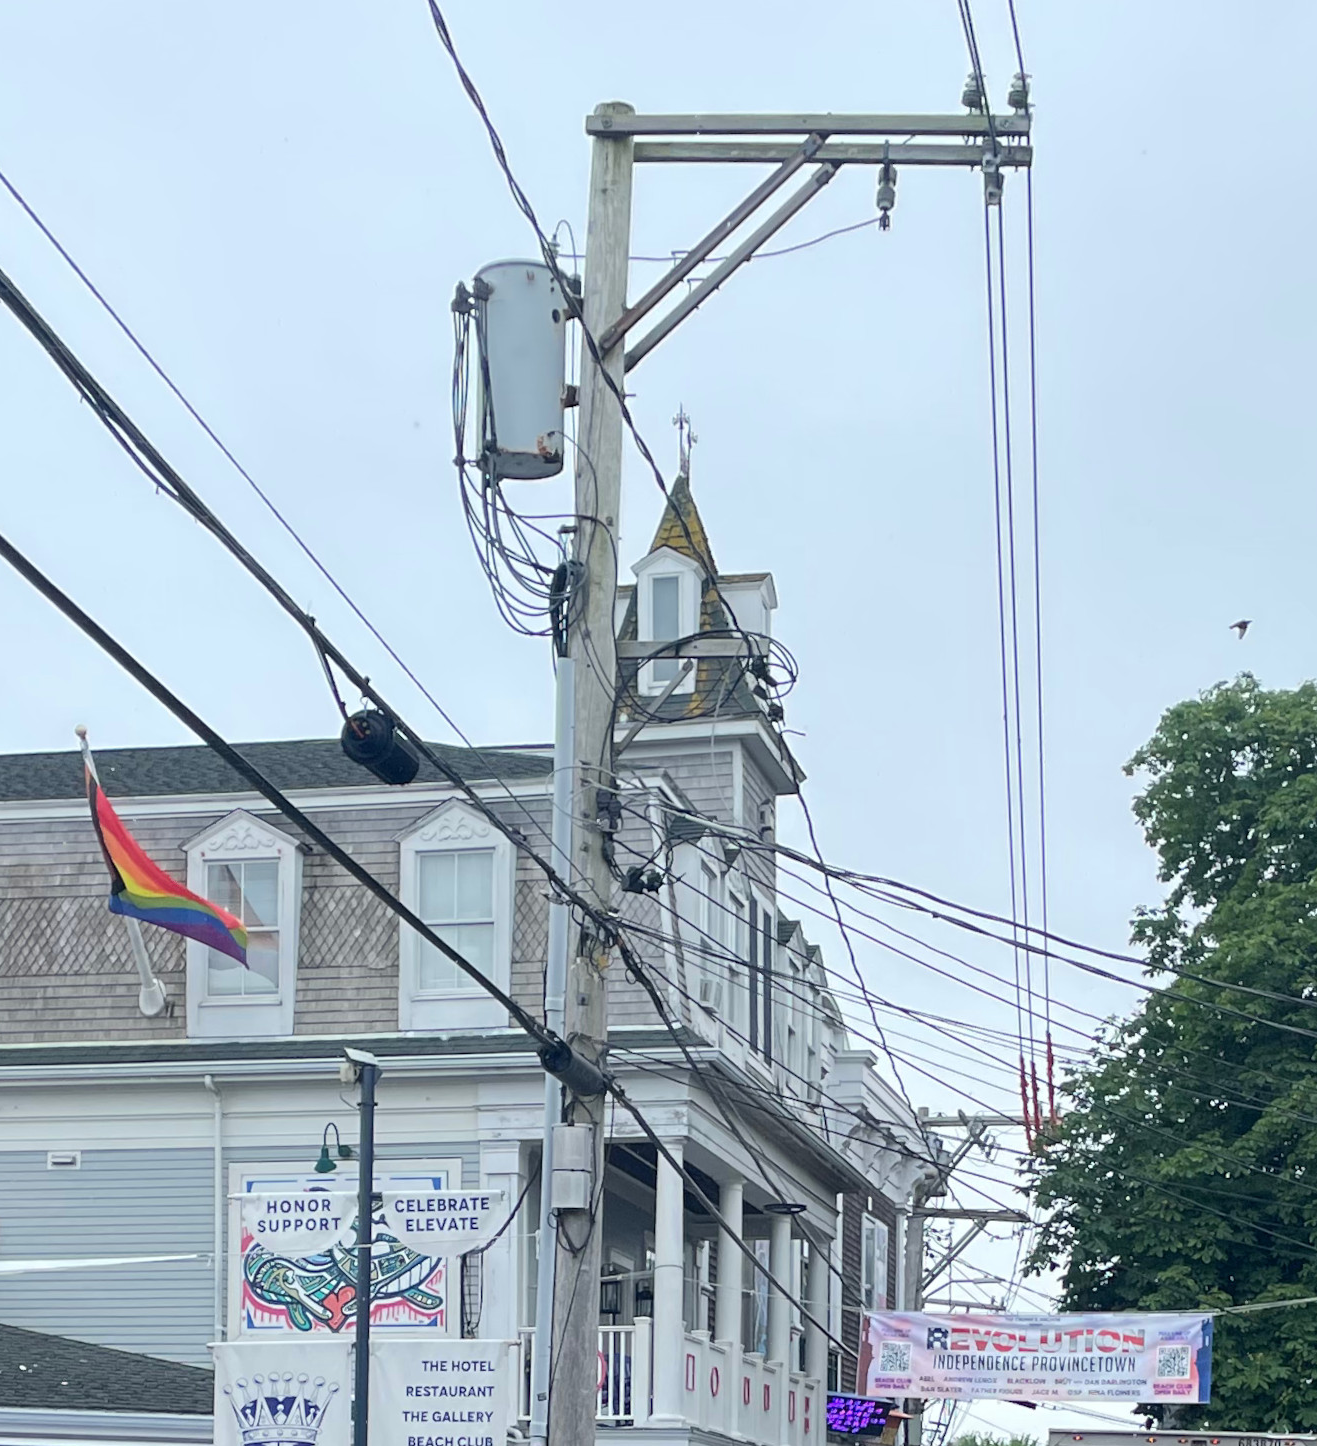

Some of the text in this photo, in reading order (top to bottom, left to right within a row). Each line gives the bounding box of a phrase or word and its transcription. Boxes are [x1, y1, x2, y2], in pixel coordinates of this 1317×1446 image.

[266, 1199, 332, 1214] HONOR
[394, 1197, 490, 1213] CELEBRATE
[257, 1217, 342, 1233] SUPPORT
[405, 1217, 480, 1232] ELEVATE
[926, 1327, 1146, 1354] REVOLUTION
[421, 1360, 495, 1372] THE HOTEL
[933, 1355, 1136, 1373] INDEPENDENCE PROVINCETOWN
[405, 1385, 495, 1398] RESTAURANT
[402, 1411, 494, 1423] THE GALLERY
